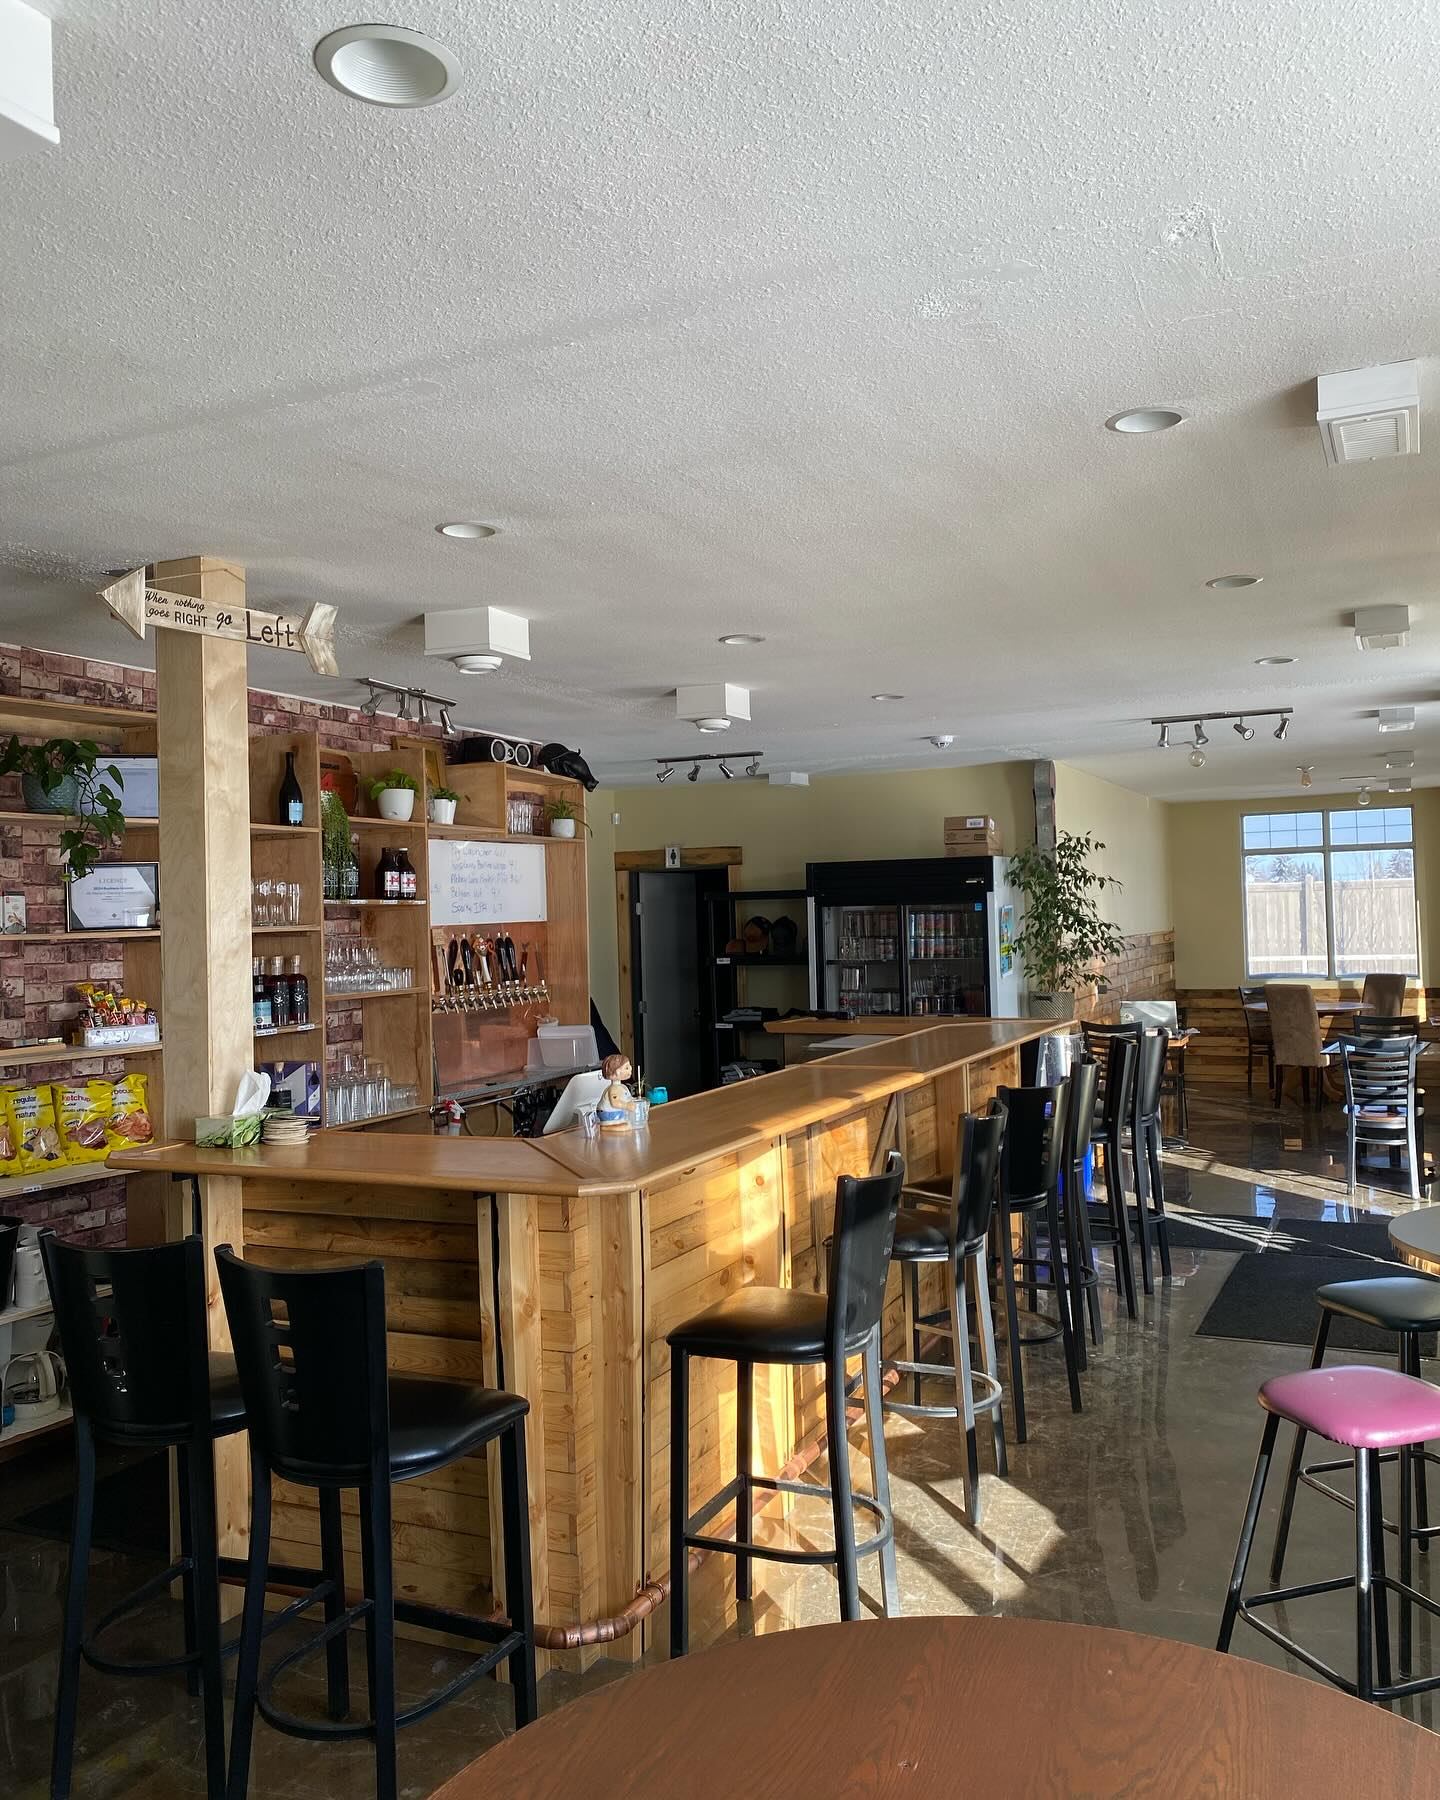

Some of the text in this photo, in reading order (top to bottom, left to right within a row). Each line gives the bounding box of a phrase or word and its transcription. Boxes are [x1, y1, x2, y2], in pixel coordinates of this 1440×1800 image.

[144, 591, 205, 613] When nothing
[146, 606, 295, 647] goes RIGHT go Left
[12, 1095, 37, 1105] regular
[62, 1094, 91, 1102] ketchup
